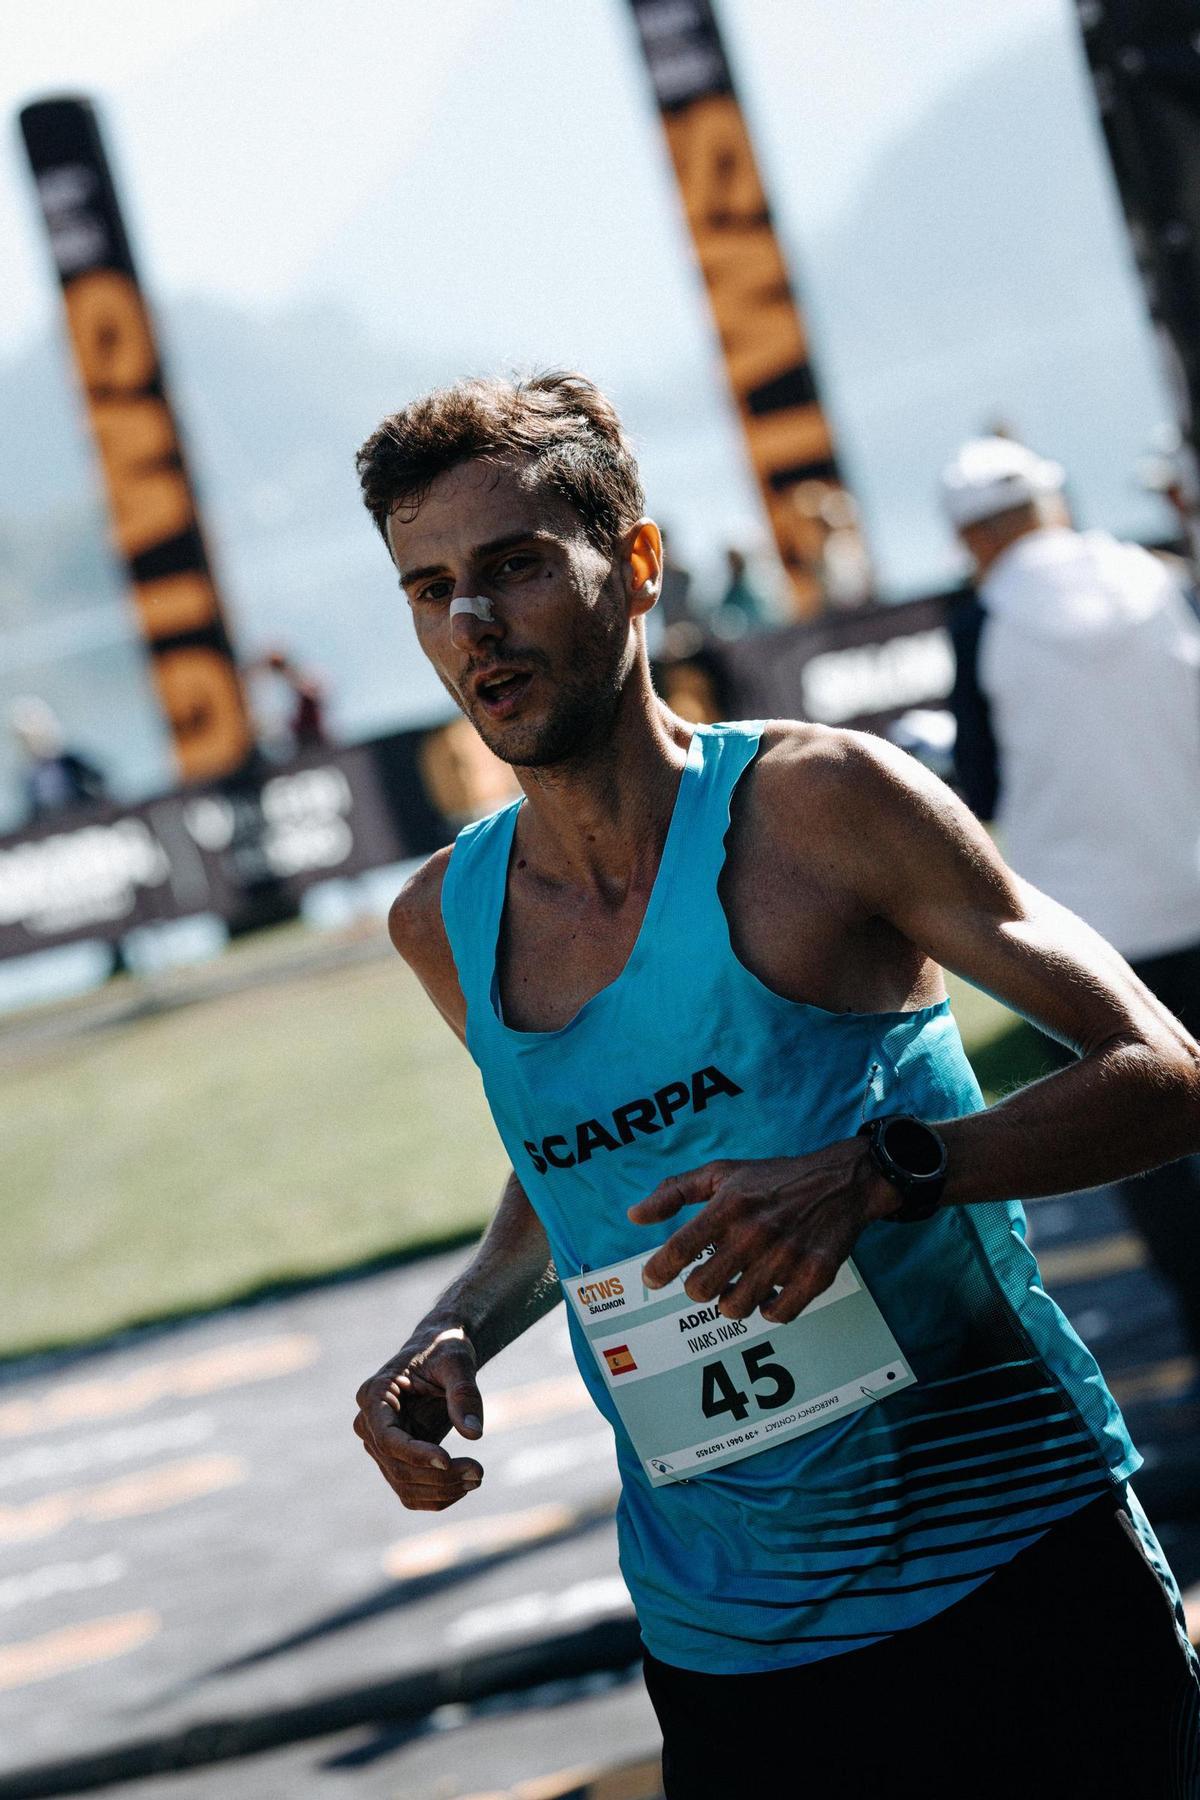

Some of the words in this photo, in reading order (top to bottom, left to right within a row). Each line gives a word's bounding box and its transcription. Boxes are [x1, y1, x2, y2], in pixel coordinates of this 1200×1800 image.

[523, 1065, 744, 1175] SCARPA
[577, 1277, 624, 1305] GTWS
[589, 1298, 625, 1314] SALOMON
[687, 1331, 718, 1353] IVARS
[716, 1320, 748, 1342] IVARS
[701, 1341, 796, 1421] 45
[798, 1395, 839, 1419] EMERGENCY
[765, 1414, 797, 1433] CONTACT
[726, 1434, 744, 1448] 0461
[744, 1430, 759, 1440] +39
[695, 1443, 725, 1458] 1637455
